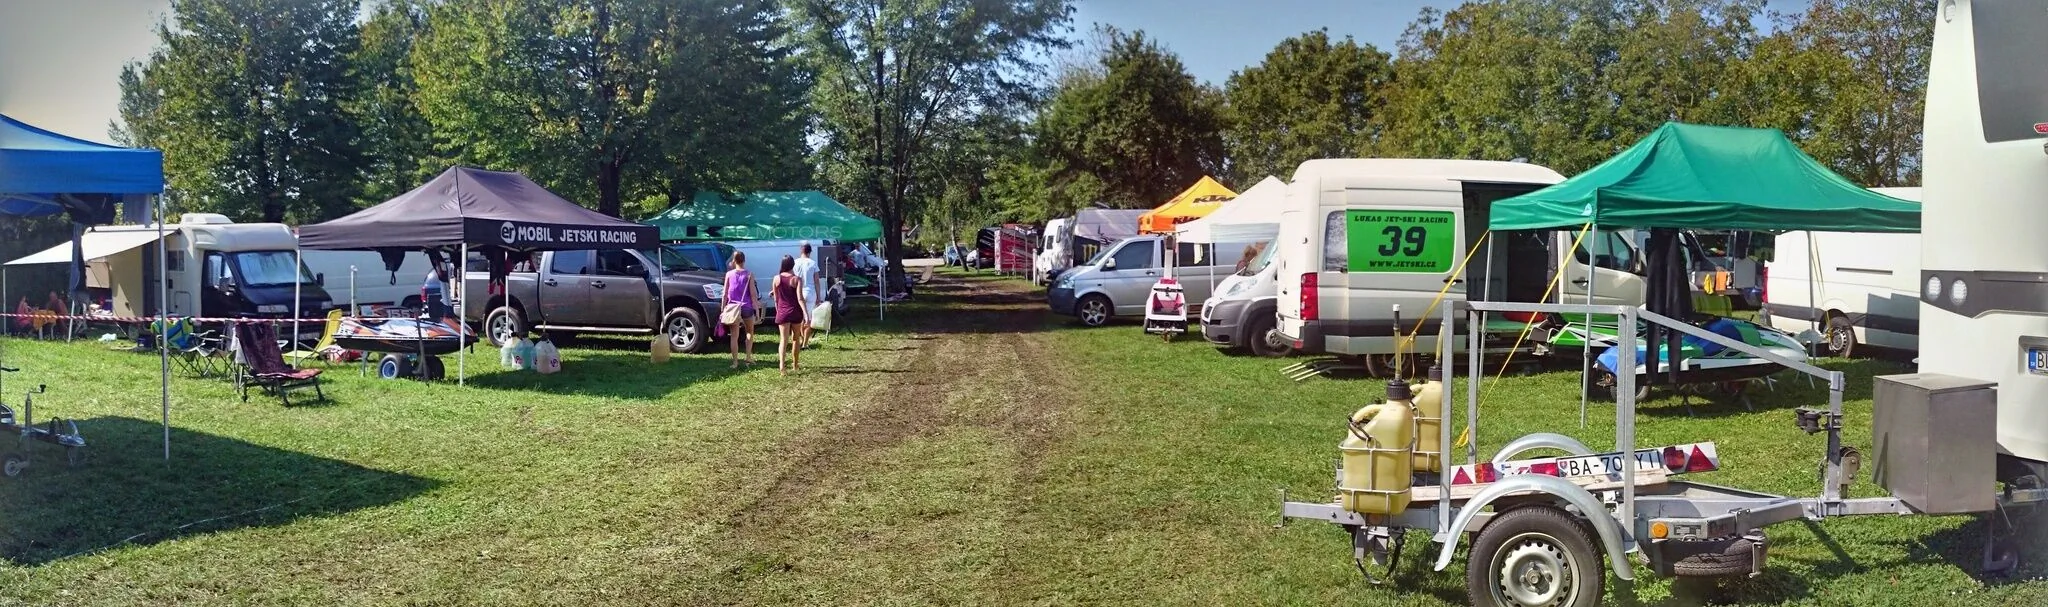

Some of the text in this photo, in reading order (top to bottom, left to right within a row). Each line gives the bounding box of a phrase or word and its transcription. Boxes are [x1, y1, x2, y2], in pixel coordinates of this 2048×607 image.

[518, 226, 553, 242] MOBIL
[560, 229, 597, 242] JETSKI
[600, 230, 637, 243] RACING
[757, 225, 843, 239] MOTORS
[1378, 226, 1426, 257] 39
[1570, 452, 1654, 476] BA-70YI
